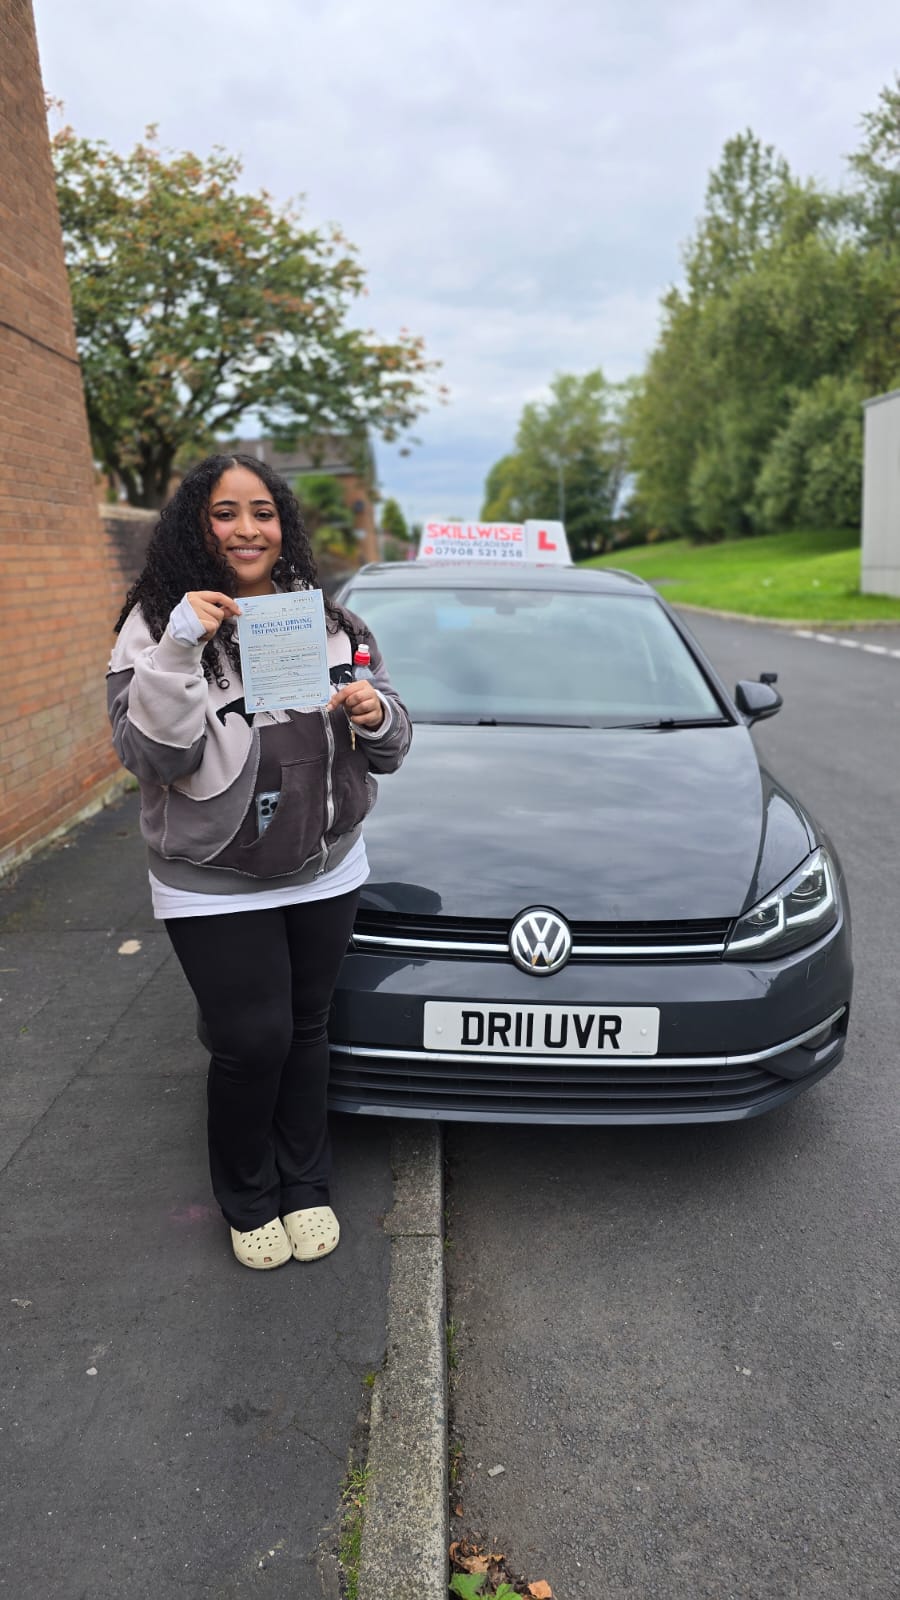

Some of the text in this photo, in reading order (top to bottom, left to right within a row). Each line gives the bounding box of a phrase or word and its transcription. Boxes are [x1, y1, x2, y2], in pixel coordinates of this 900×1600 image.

[427, 523, 523, 542] SKILLWISE
[538, 530, 557, 550] L
[435, 546, 523, 558] 07908 521 258
[250, 617, 312, 630] PRACTICAL DRIVING
[279, 623, 312, 633] CERTIFICATE
[544, 1013, 622, 1049] UVR
